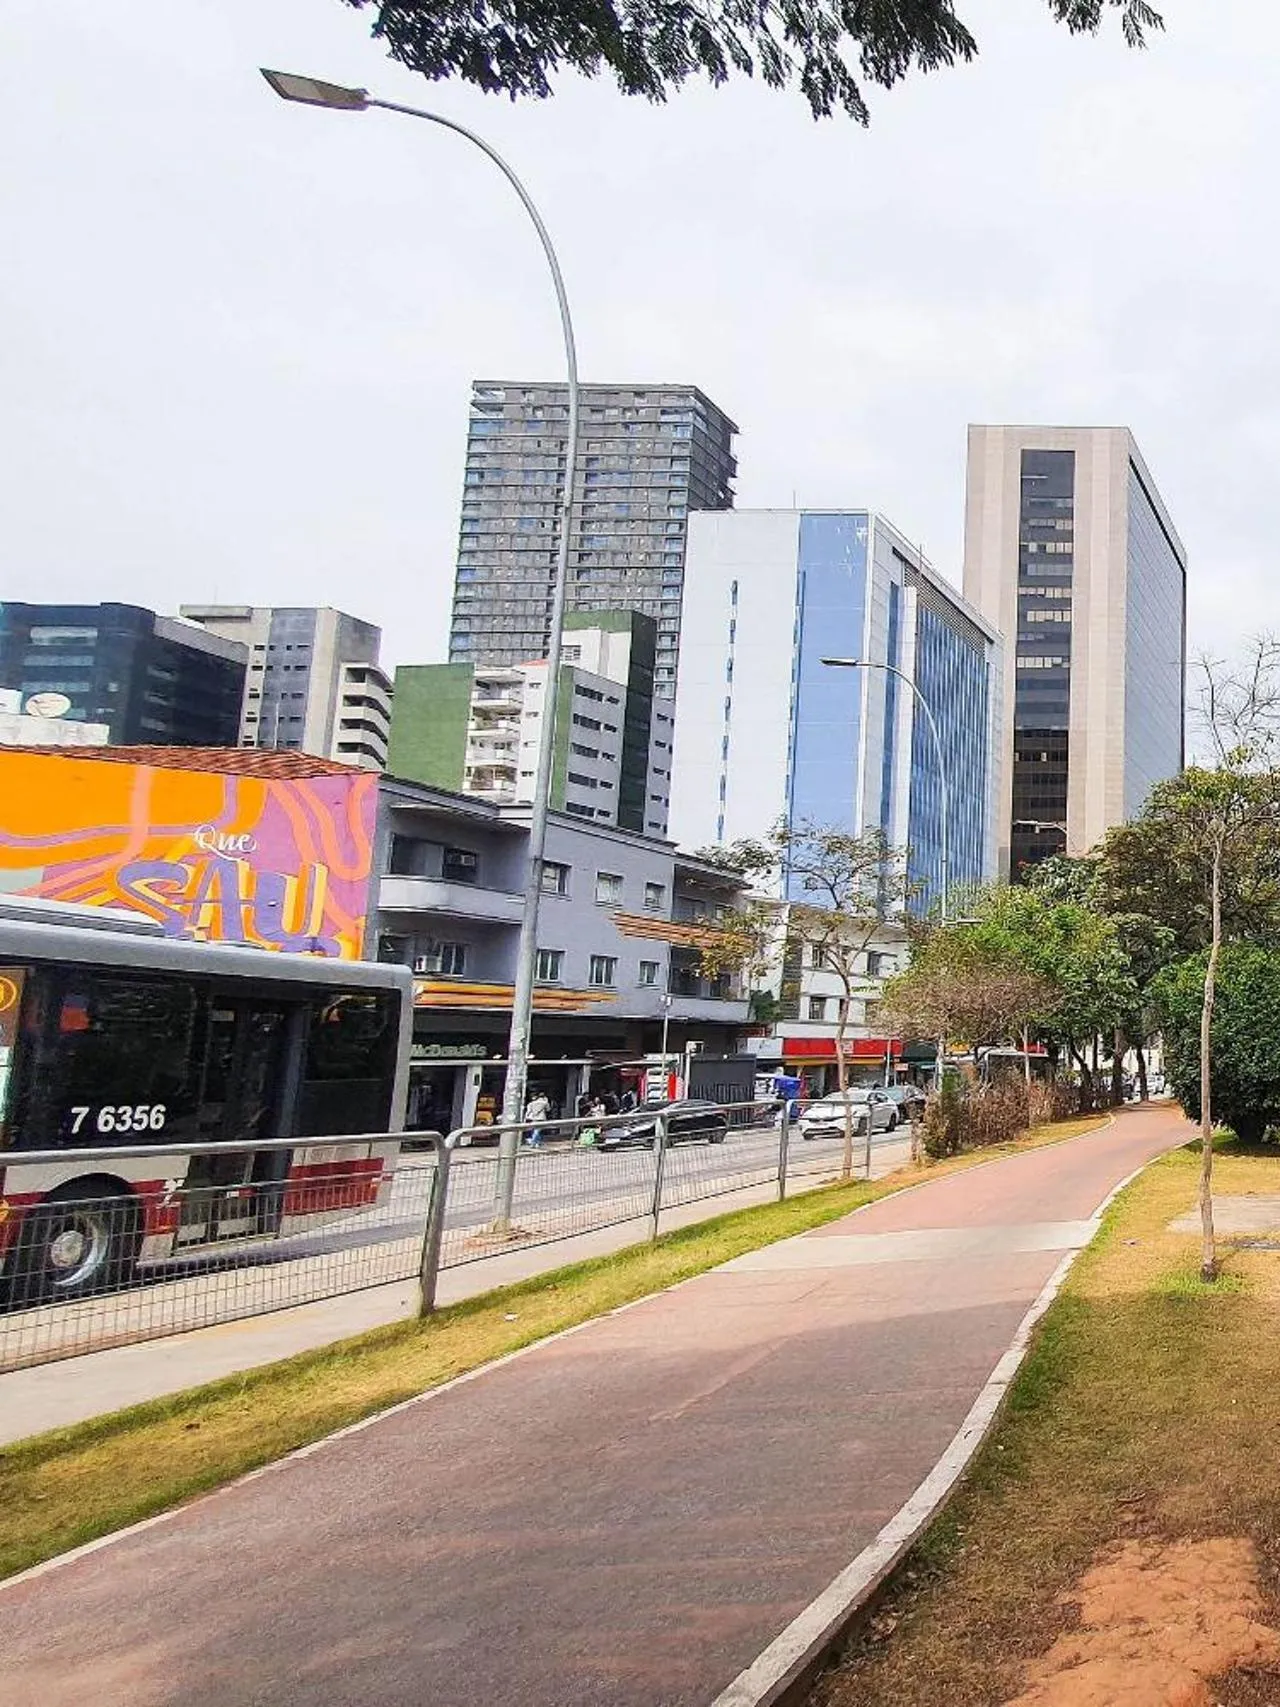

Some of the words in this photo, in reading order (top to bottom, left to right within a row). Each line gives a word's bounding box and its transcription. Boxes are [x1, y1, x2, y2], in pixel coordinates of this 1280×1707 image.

[190, 824, 257, 861] Que
[71, 1106, 90, 1134] 7
[97, 1104, 166, 1132] 6356
